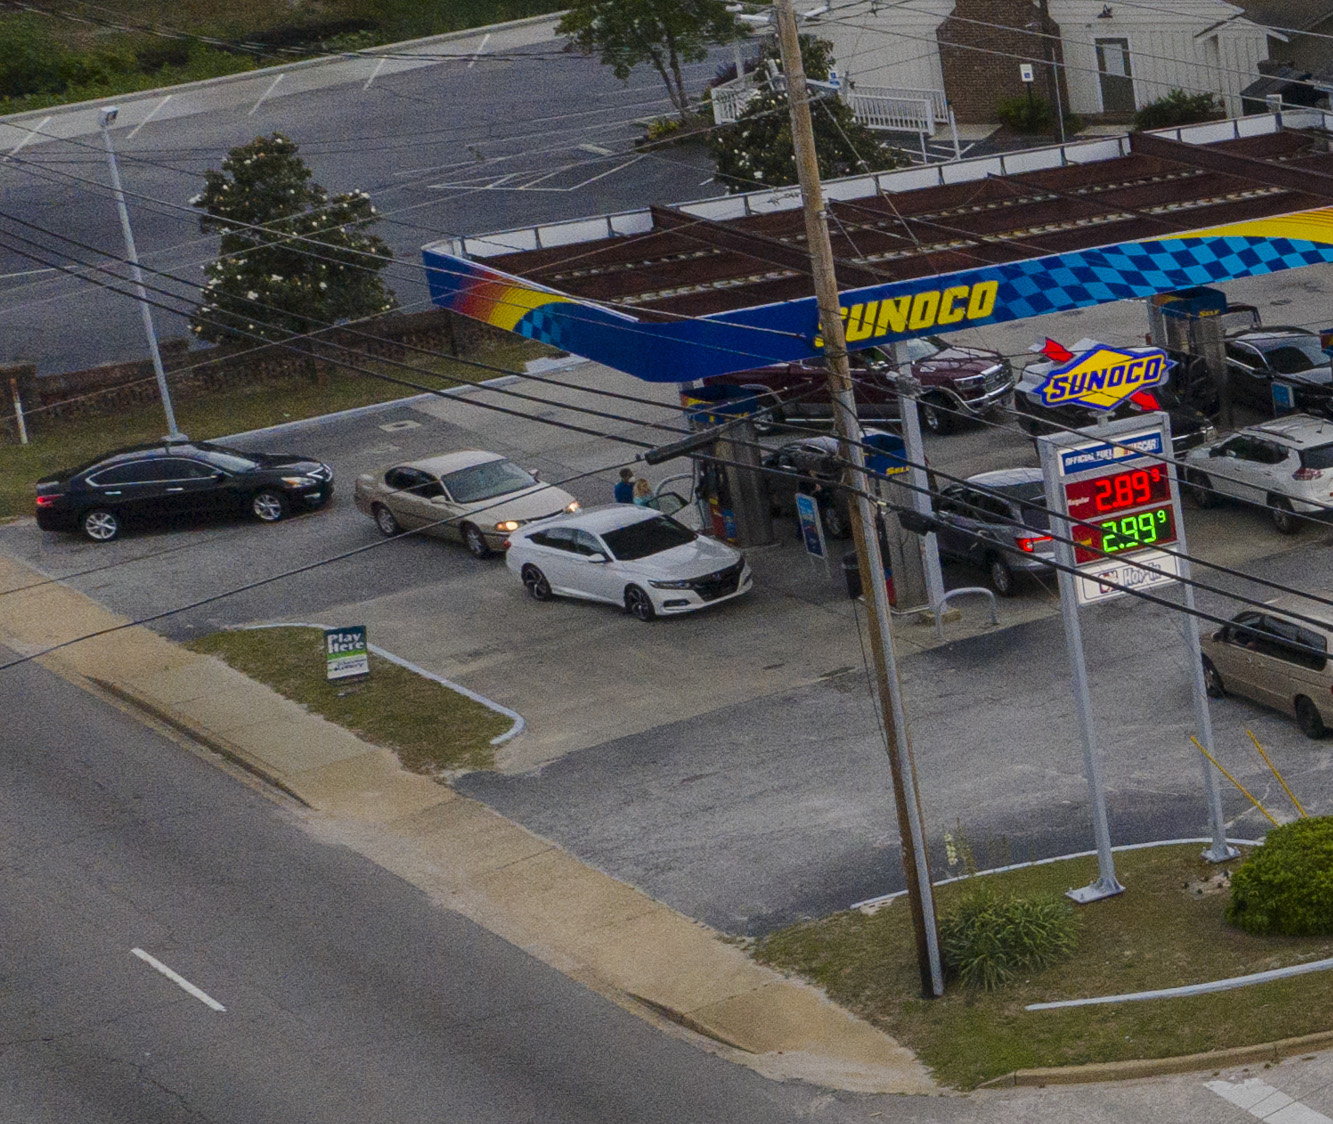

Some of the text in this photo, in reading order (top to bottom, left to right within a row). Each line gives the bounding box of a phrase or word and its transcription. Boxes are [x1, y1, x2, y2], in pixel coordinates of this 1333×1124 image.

[1049, 357, 1163, 400] SUNOCO
[327, 632, 362, 645] Play
[327, 641, 365, 654] Here
